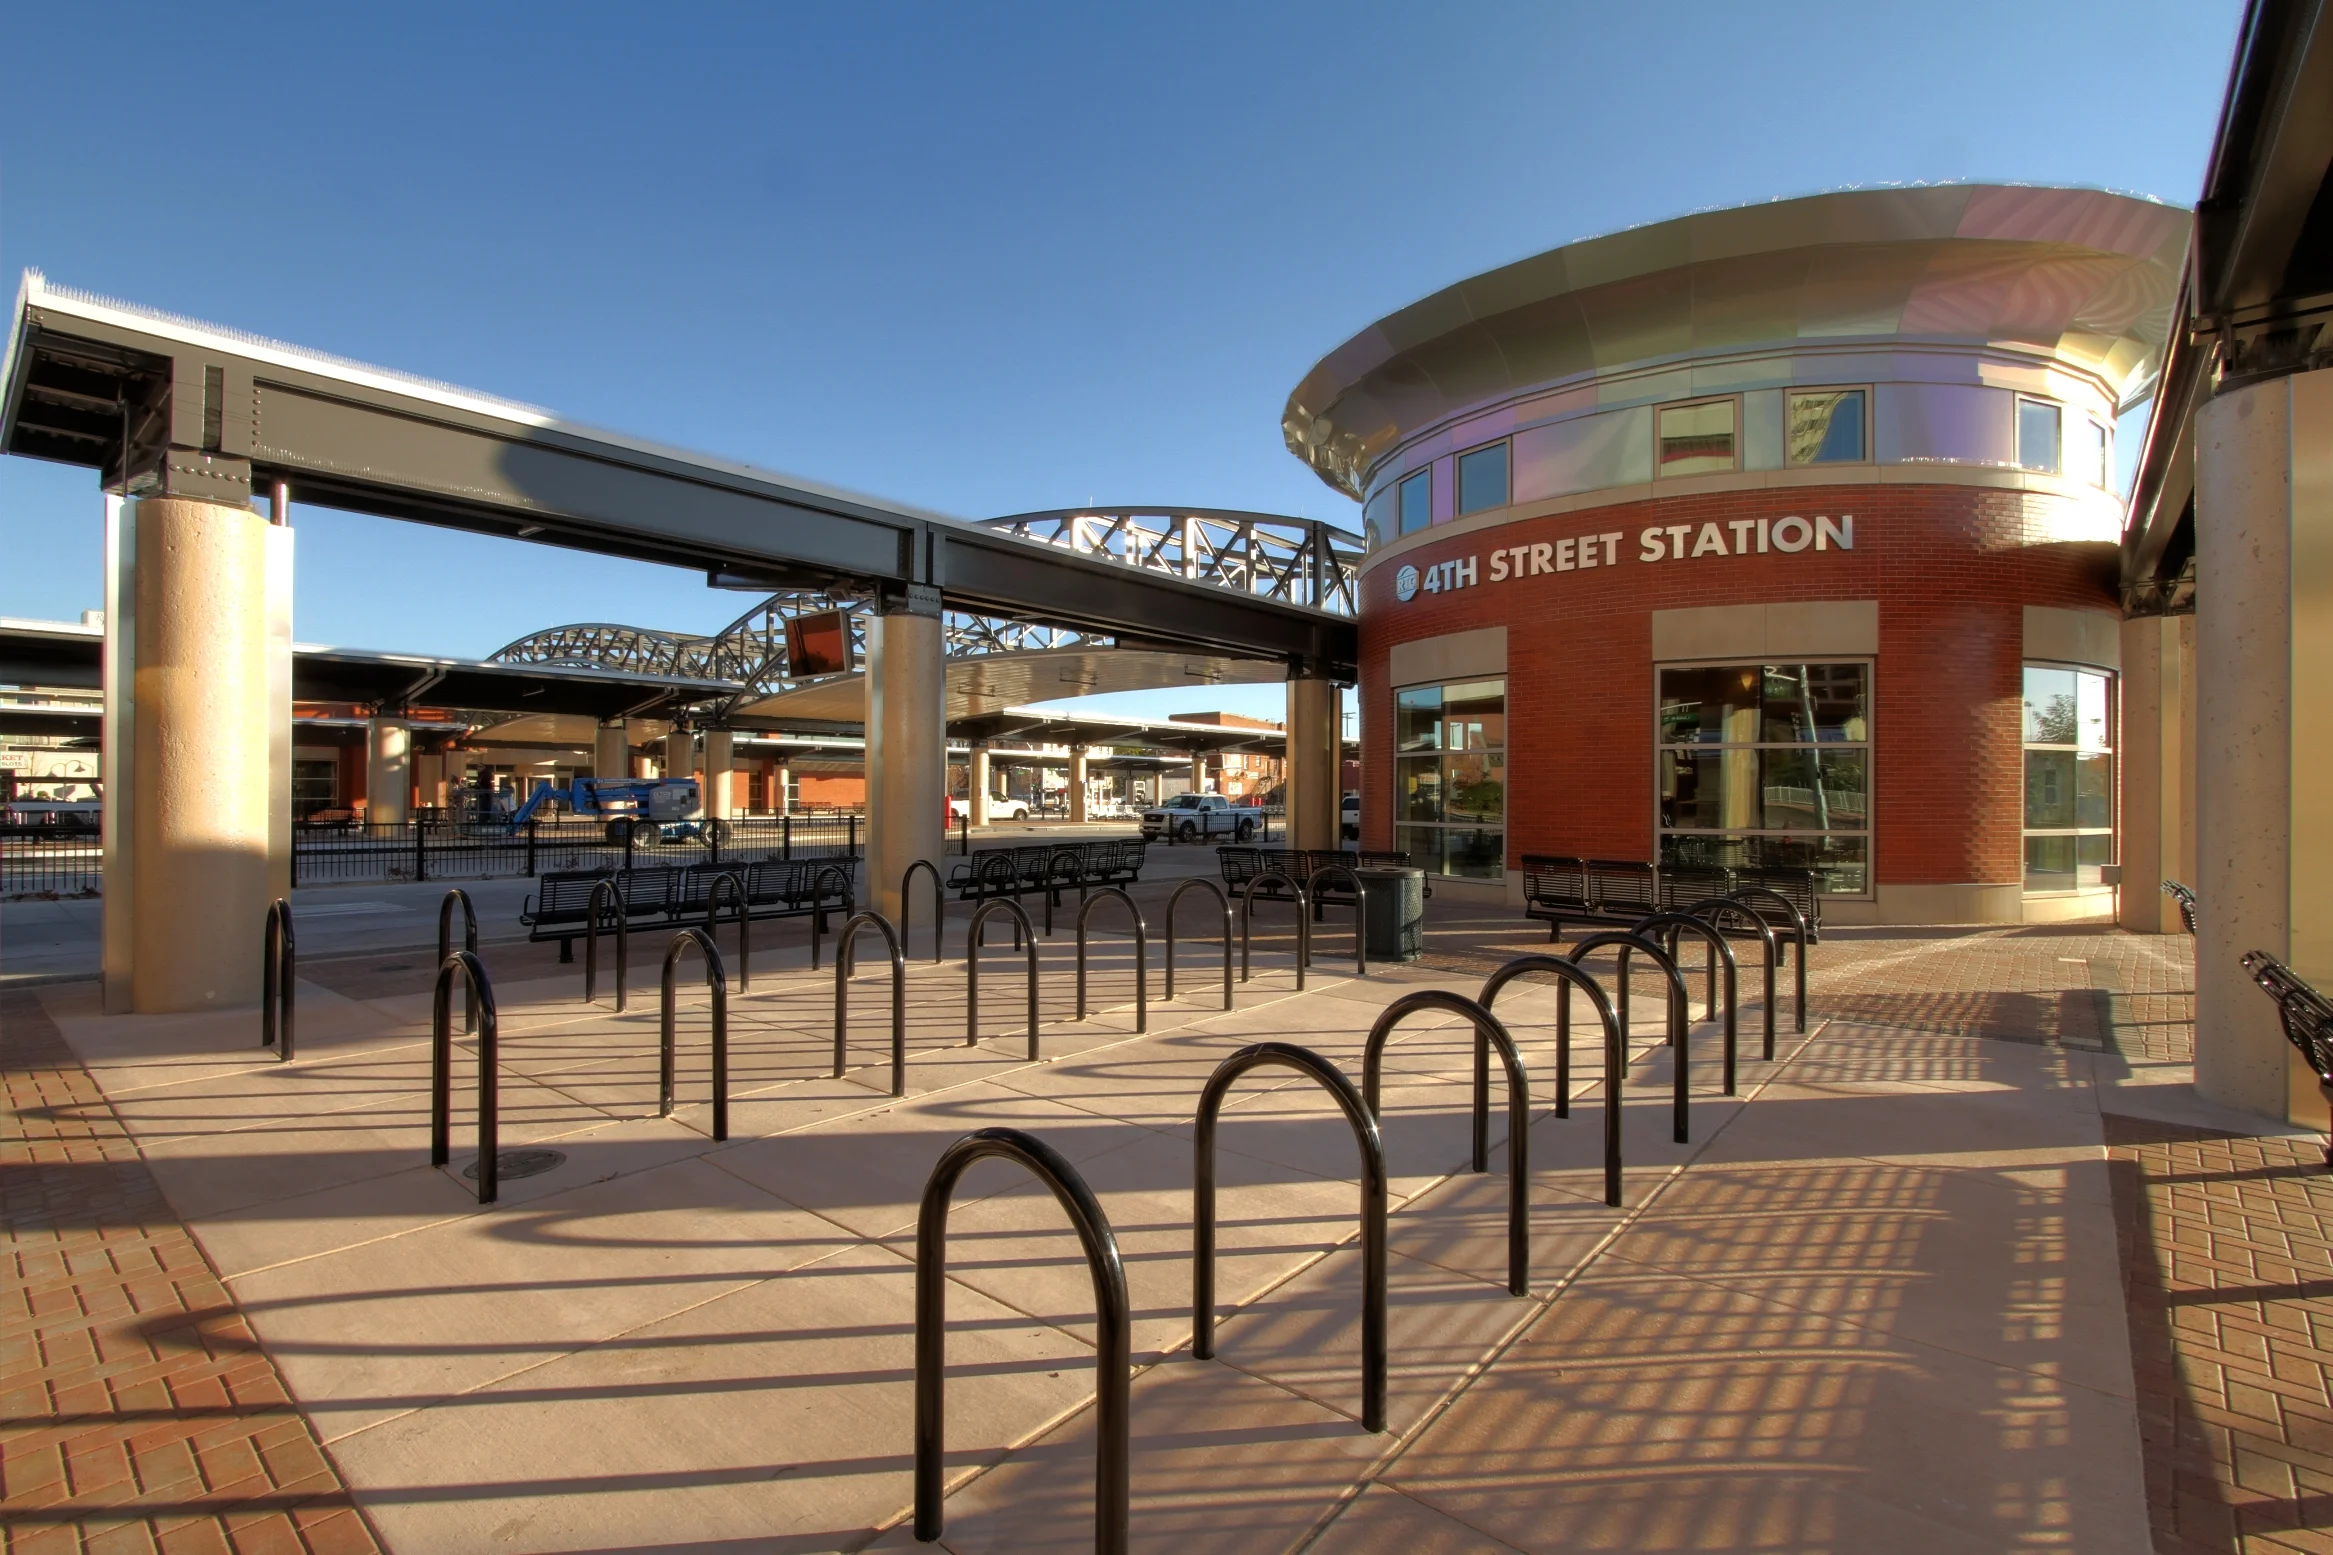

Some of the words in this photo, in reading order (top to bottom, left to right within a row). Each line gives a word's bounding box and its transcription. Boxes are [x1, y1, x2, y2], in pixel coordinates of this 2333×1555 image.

[1423, 555, 1479, 594] 4TH
[1489, 531, 1623, 582] STREET
[1639, 515, 1853, 562] STATION
